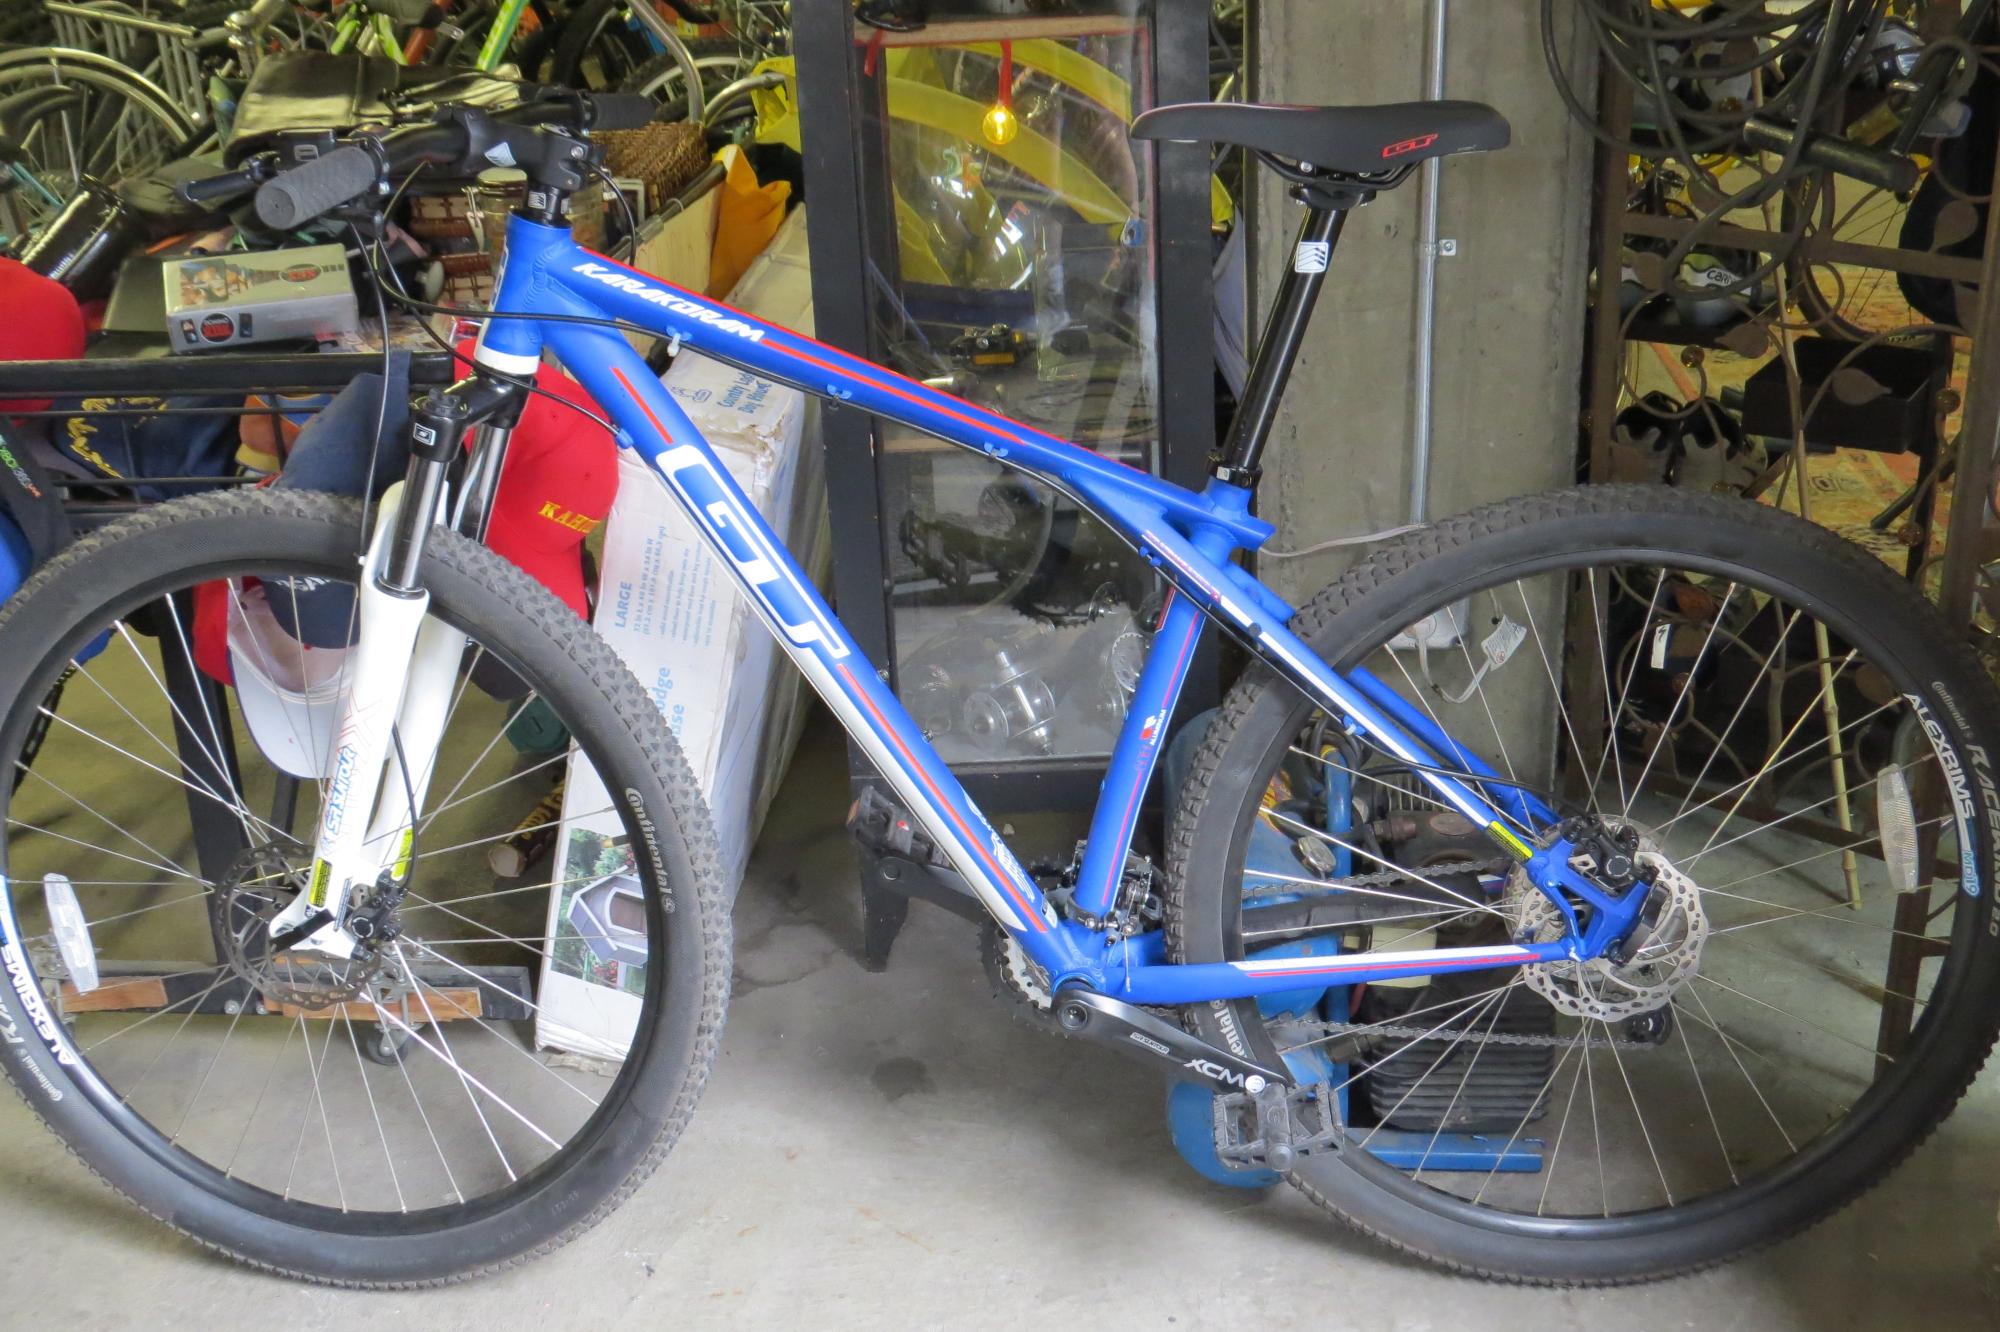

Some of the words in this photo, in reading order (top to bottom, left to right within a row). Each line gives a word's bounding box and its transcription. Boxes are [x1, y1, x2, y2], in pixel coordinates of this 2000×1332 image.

[572, 262, 765, 342] KARAKORAM
[656, 445, 851, 659] GT
[615, 581, 632, 627] LARGE
[651, 667, 674, 710] odge
[671, 704, 685, 735] use
[1932, 681, 1970, 731] Continental
[333, 746, 357, 809] SUNTOUR
[1903, 692, 1976, 820] ALEXRIMS
[625, 787, 673, 894] Continental
[1, 946, 77, 1066] ALEXRIMS
[1184, 1058, 1245, 1088] XCM
